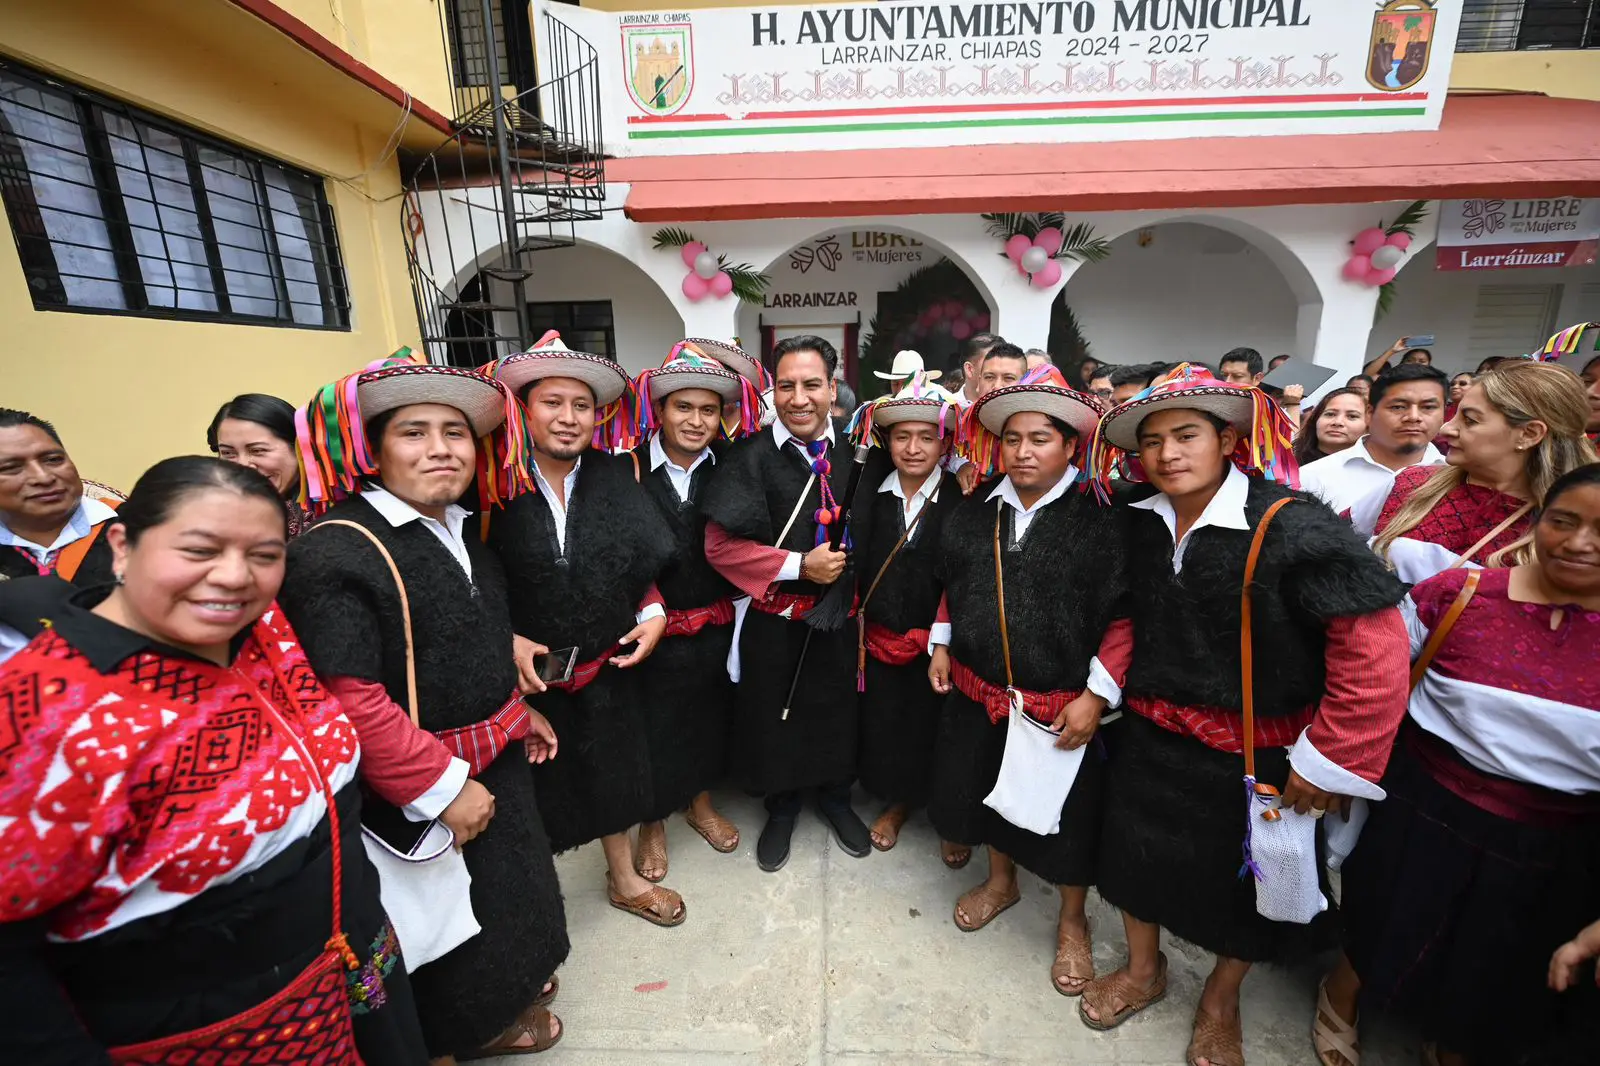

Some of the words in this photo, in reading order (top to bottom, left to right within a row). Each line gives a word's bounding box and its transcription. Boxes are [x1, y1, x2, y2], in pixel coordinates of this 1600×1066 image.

[619, 14, 660, 24] LARRAINZAR
[664, 13, 692, 22] CHIAPAS
[751, 12, 786, 46] H.
[796, 1, 1095, 45] AYUNTAMIENTO
[1112, 0, 1311, 32] MUNICIPAL
[961, 40, 1042, 59] CHIAPAS
[1066, 36, 1120, 56] 2024
[1148, 34, 1209, 54] 2027
[1512, 199, 1581, 218] LIBRE
[1524, 220, 1577, 234] Mujeres
[867, 248, 922, 264] Mujeres
[1460, 249, 1565, 268] Larráinzar
[763, 292, 858, 308] LARRAINZAR
